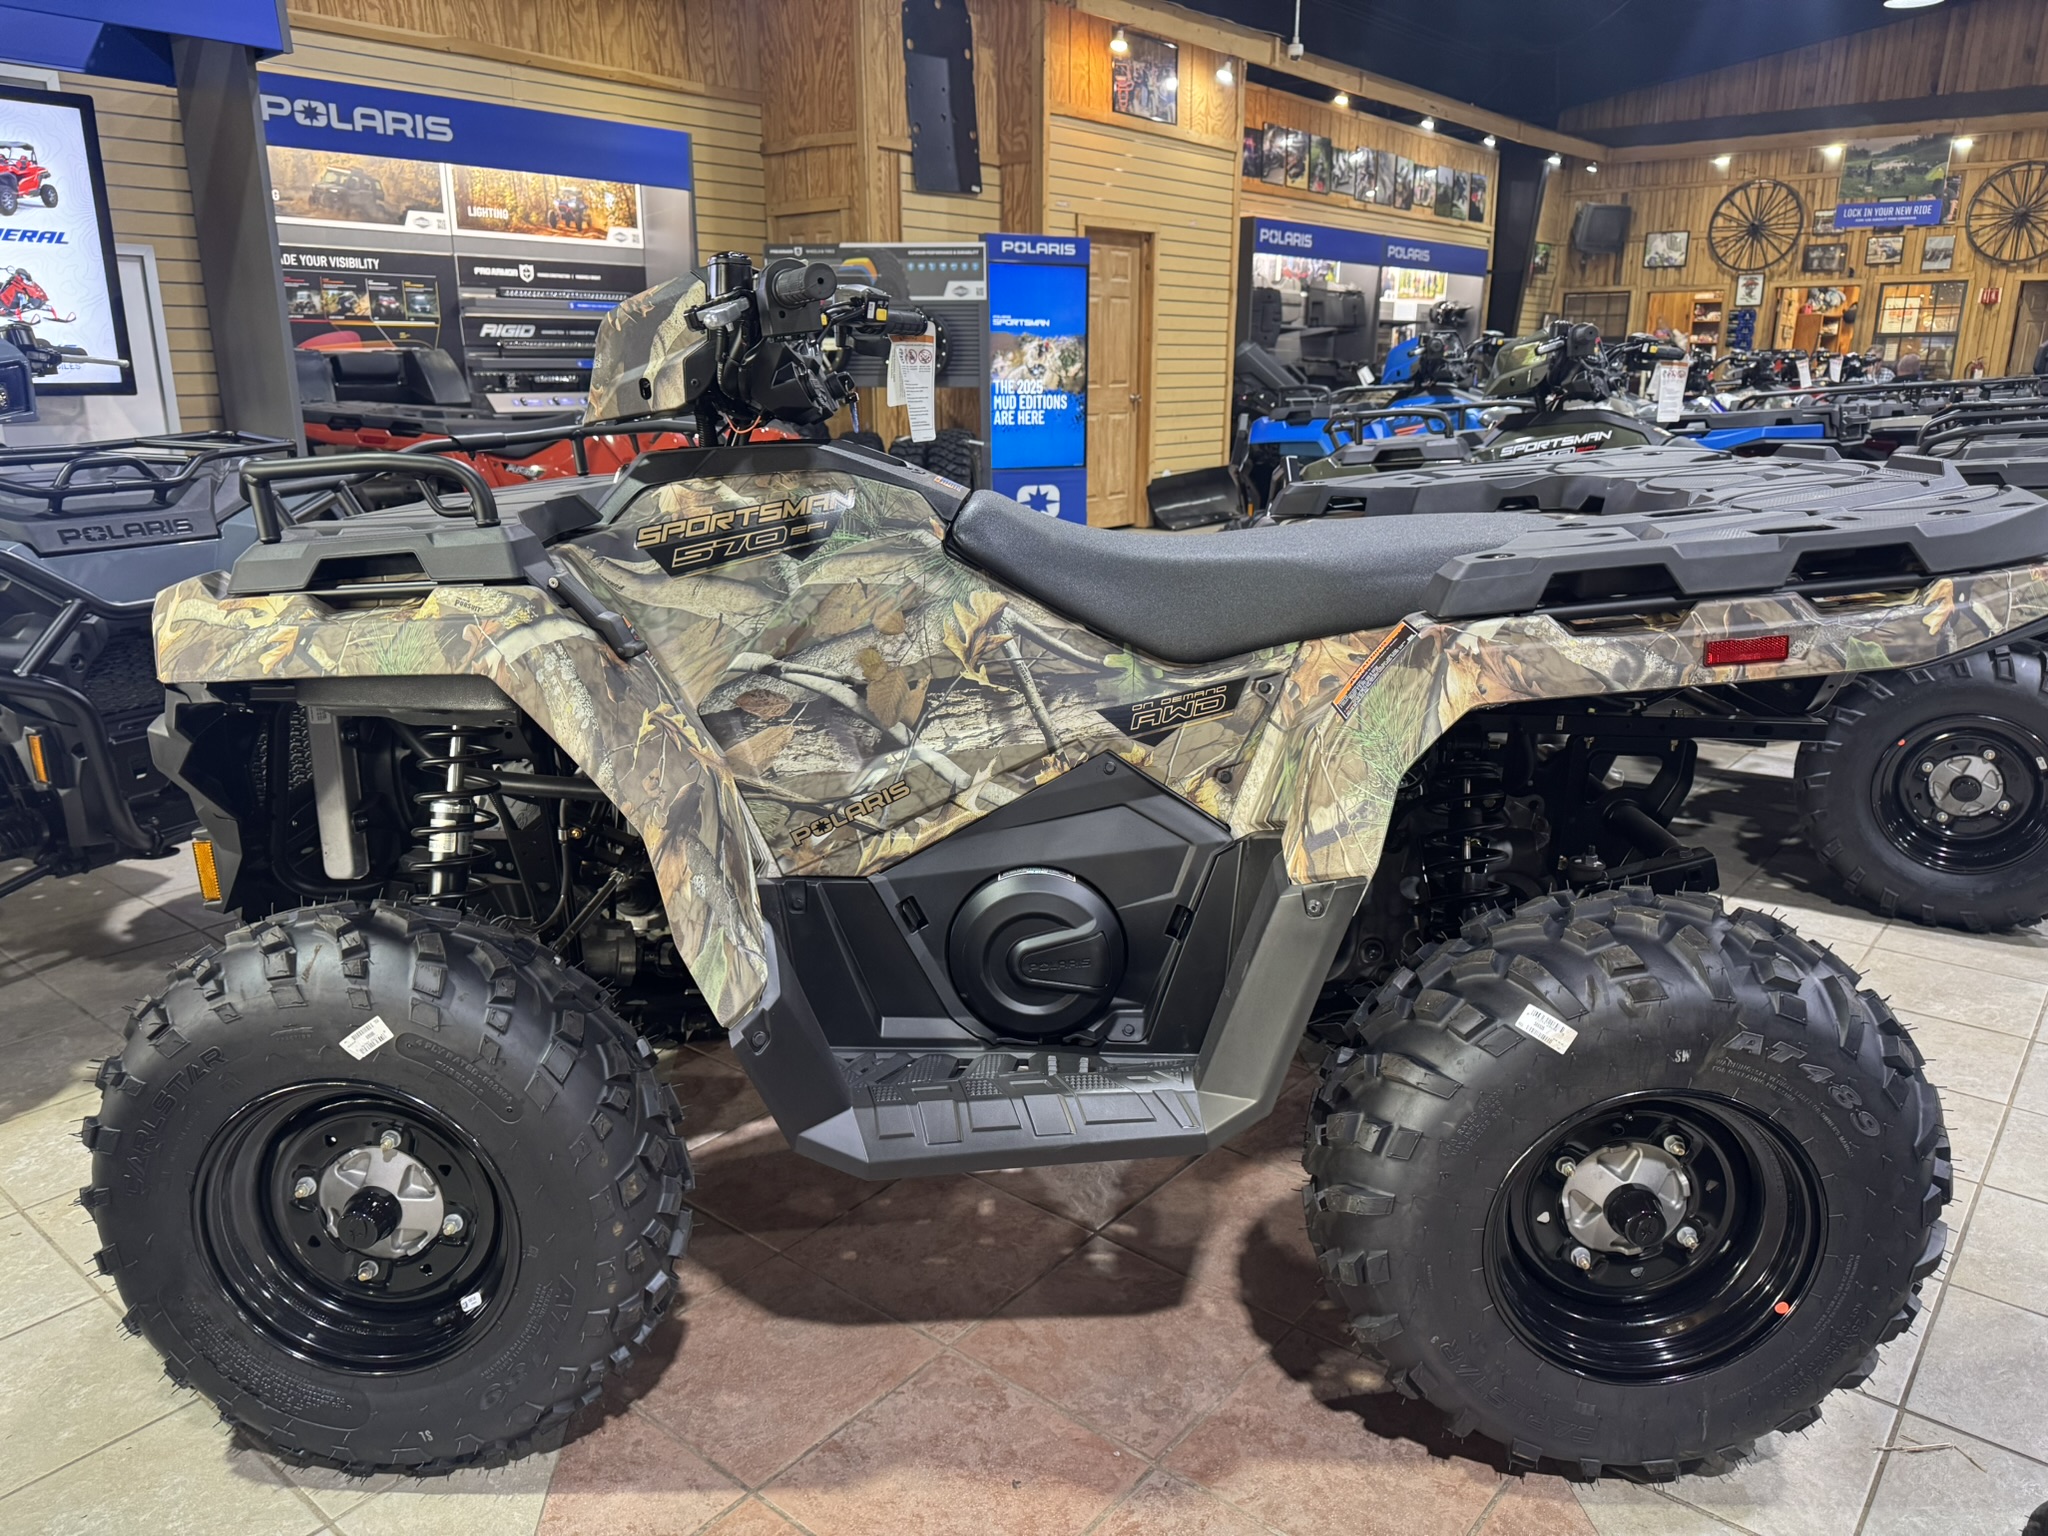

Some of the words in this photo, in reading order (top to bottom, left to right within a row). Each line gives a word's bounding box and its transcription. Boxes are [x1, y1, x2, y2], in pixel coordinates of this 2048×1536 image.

[260, 94, 454, 142] POLARIS
[467, 205, 509, 220] LIGHTING
[1843, 207, 1863, 219] LOCK
[1863, 207, 1872, 218] IN
[1874, 206, 1893, 217] YOUR
[1895, 205, 1912, 216] NEW
[1913, 204, 1933, 215] RIDE
[1260, 228, 1313, 248] POLARIS
[1001, 240, 1076, 257] POLARIS
[1387, 245, 1430, 262] POLARIS
[299, 255, 328, 268] YOUR
[328, 257, 380, 270] VISIBILITY
[479, 323, 536, 338] RIGID
[992, 318, 1051, 328] SPORTSMAN
[993, 379, 1016, 394] THE
[1016, 379, 1043, 395] 2025
[993, 395, 1017, 410] MUD
[1019, 395, 1068, 410] EDITIONS
[993, 410, 1015, 425] ARE
[1018, 411, 1045, 426] HERE
[1499, 429, 1613, 457] SPORTSMAN
[635, 487, 856, 549] SPORTSMAN
[57, 518, 194, 545] POLARIS
[671, 525, 788, 570] 570
[789, 521, 829, 537] EFI
[1131, 701, 1157, 712] ON
[1160, 685, 1228, 706] DEMAND
[1130, 694, 1229, 731] AWD
[788, 779, 912, 847] POLARIS
[1027, 957, 1092, 974] POLARIS
[122, 1044, 229, 1198] CARLSTAR
[1455, 1110, 1479, 1136] RATED
